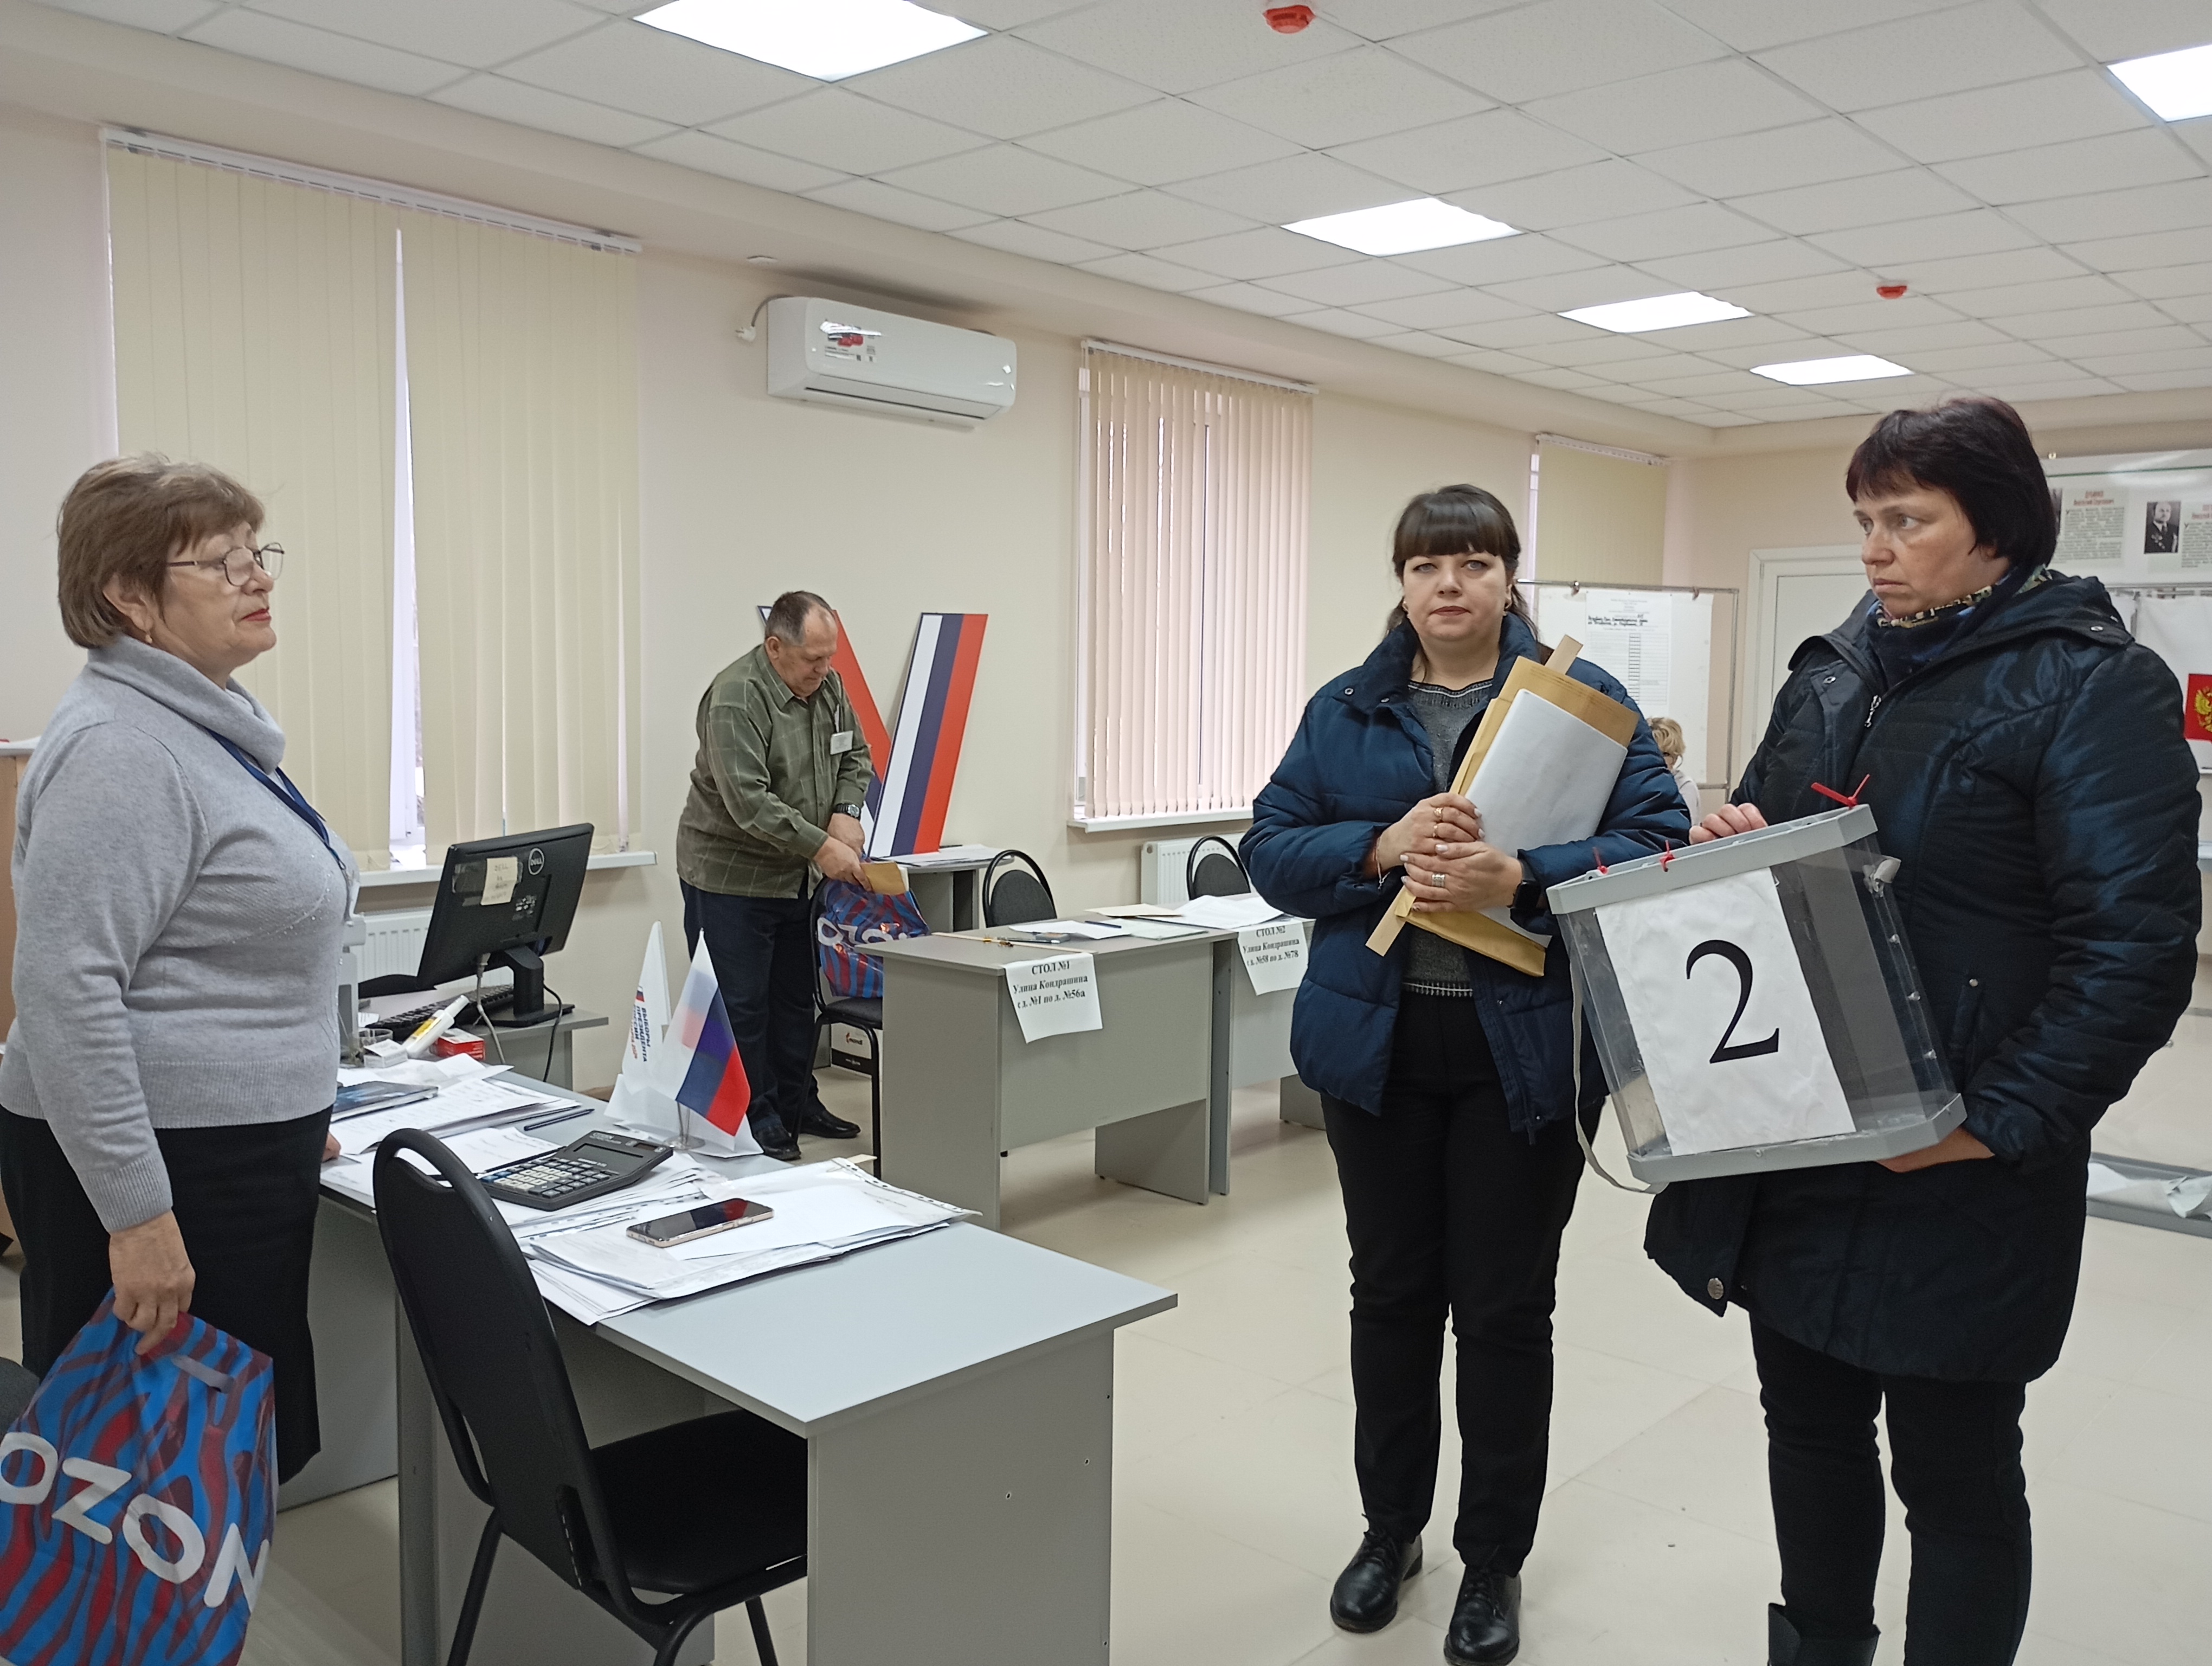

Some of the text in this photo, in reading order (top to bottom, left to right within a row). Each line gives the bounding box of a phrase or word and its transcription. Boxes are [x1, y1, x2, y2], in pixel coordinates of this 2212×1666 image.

[818, 917, 908, 949] OZO
[1256, 925, 1285, 937] СТОЛ №2
[1243, 939, 1300, 953] Улица Кондрашина
[1284, 950, 1298, 959] №78
[1032, 960, 1070, 975] СТОЛ №1
[1013, 975, 1088, 994] Улица Кондрашина
[1030, 995, 1041, 1007] №1
[1044, 995, 1053, 1003] по
[1063, 989, 1085, 1001] №56а
[1686, 940, 1779, 1063] 2
[636, 1005, 647, 1062] ПРЕЗИДЕНТА
[641, 1007, 651, 1047] ВЫБОРЫ
[0, 1431, 270, 1614] OZON
